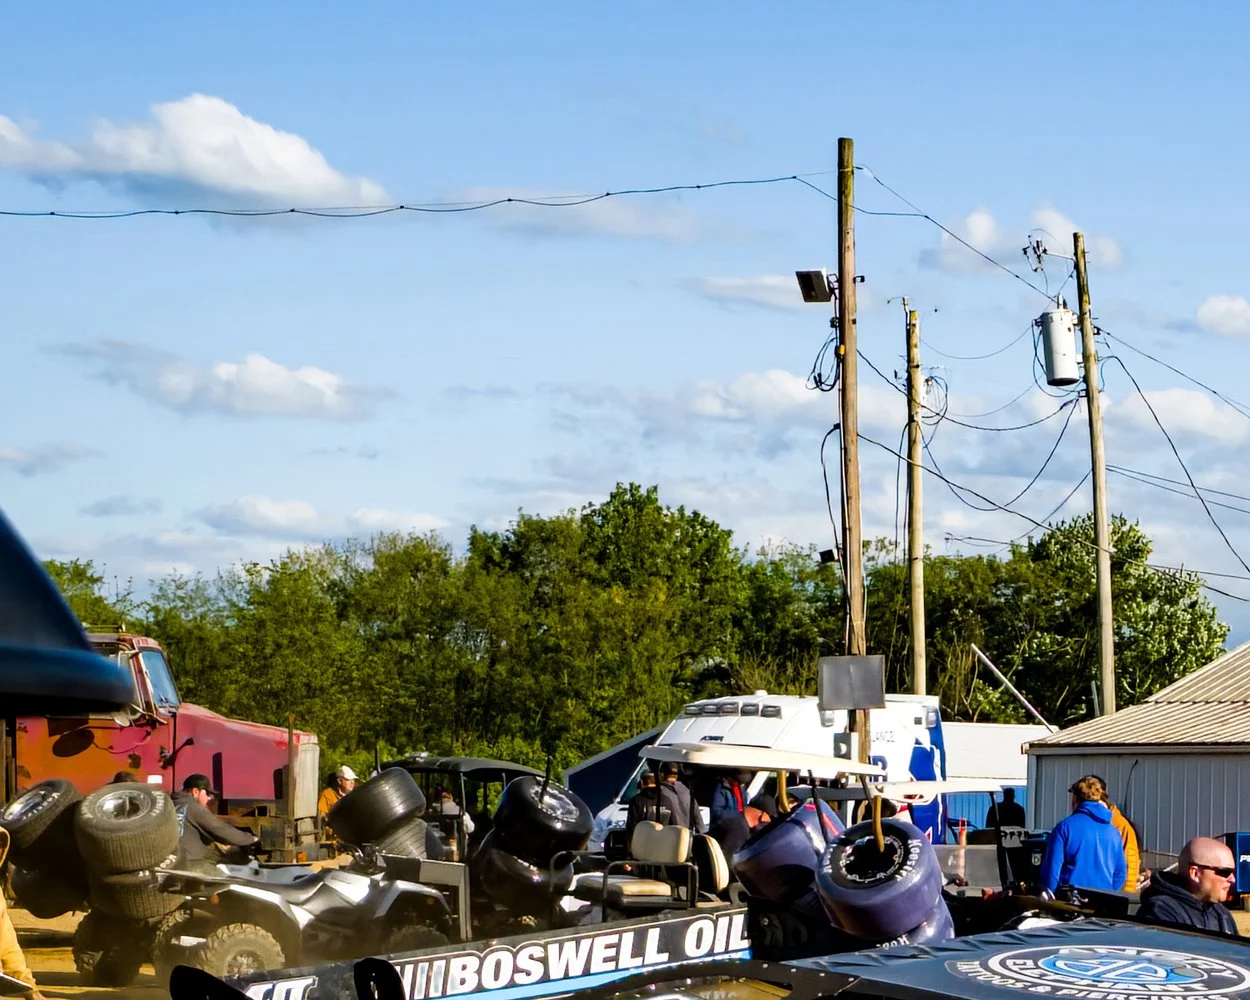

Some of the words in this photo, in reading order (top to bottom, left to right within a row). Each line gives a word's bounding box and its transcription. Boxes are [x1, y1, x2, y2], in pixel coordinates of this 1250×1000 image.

[455, 927, 669, 992] BOSWELL
[684, 912, 750, 956] OIL
[1006, 959, 1209, 991] ELEPHANT
